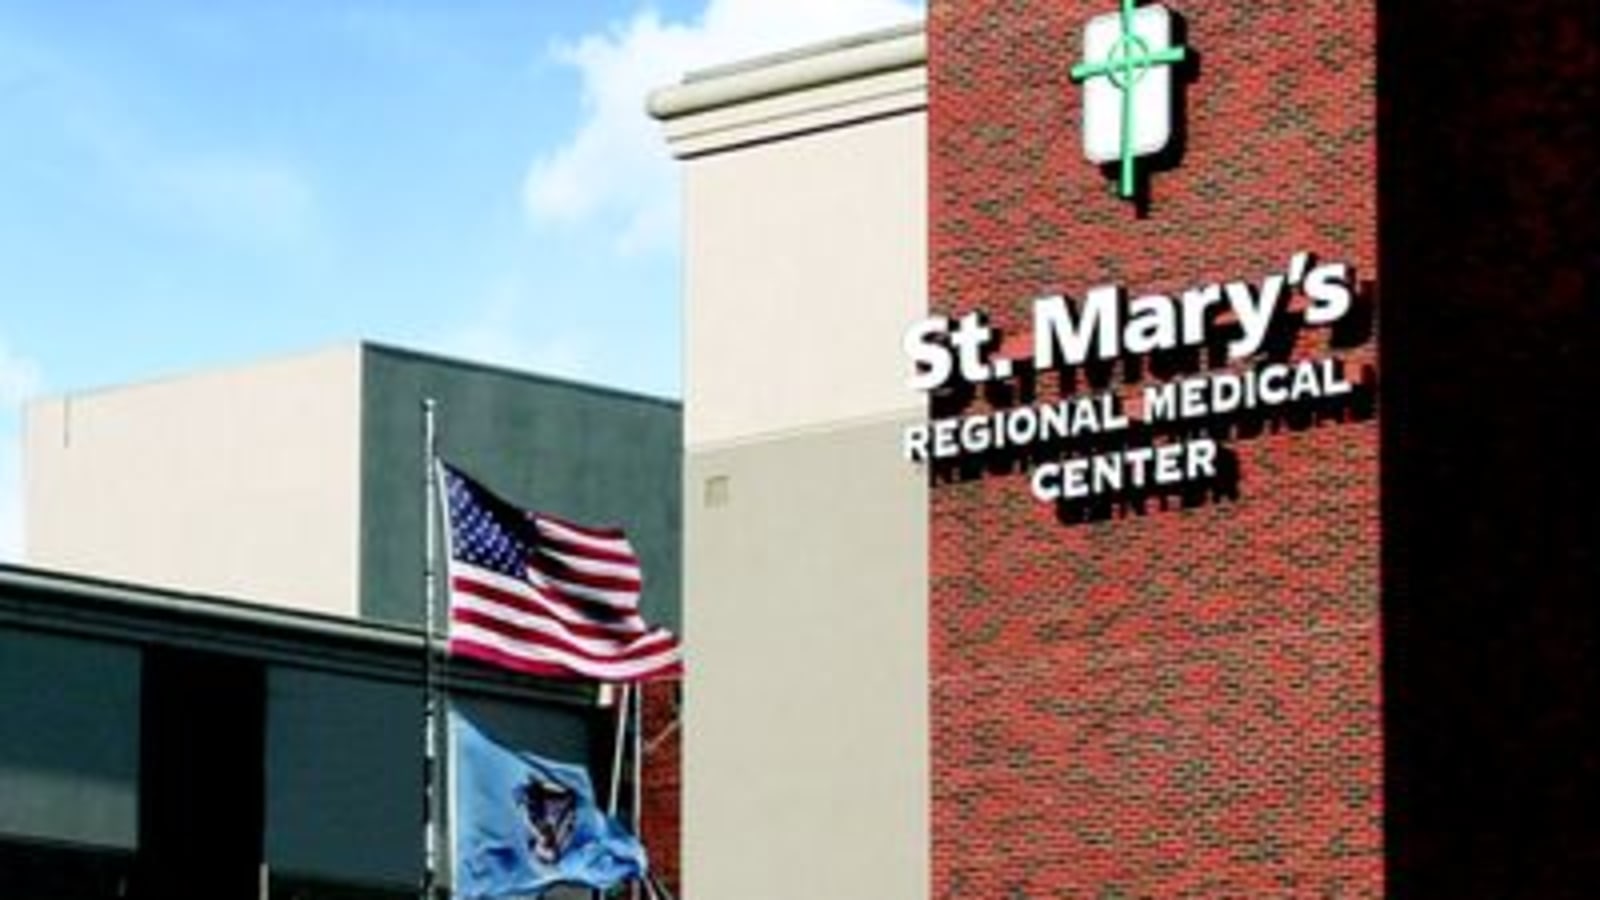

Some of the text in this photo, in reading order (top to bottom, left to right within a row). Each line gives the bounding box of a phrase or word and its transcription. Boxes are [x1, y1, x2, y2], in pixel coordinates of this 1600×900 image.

[903, 252, 1352, 390] St. Mary's
[904, 359, 1352, 462] REGIONAL MEDICAL
[1031, 439, 1217, 500] CENTER
